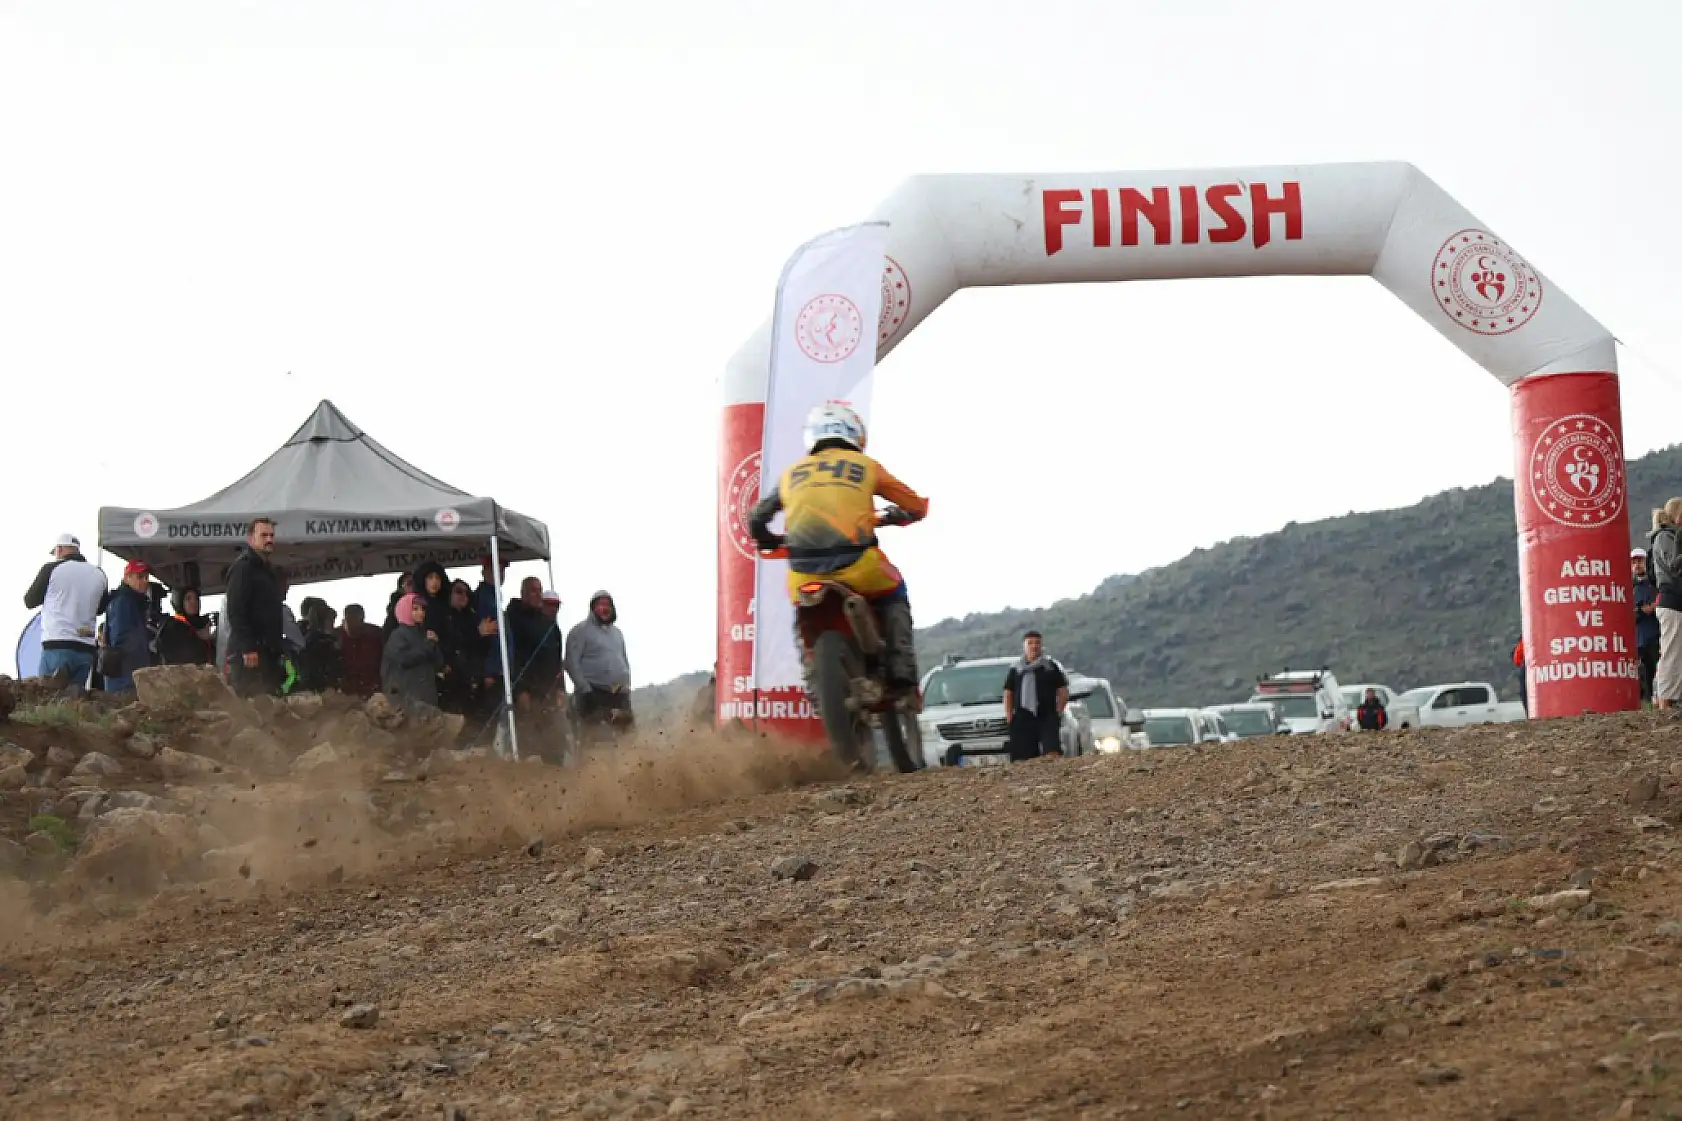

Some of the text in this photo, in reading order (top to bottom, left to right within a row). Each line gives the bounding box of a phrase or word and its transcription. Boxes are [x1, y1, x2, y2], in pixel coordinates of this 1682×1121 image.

[1043, 181, 1303, 257] FINISH
[168, 516, 428, 538] DOĞUBAYA KAYMAKAMLIĞI
[1561, 555, 1611, 578] AĞRI
[1544, 581, 1626, 606] GENÇLİK
[1576, 610, 1603, 627] VE
[1550, 631, 1628, 656] SPOR İL
[1535, 656, 1640, 684] MÜDÜRLÜĞ
